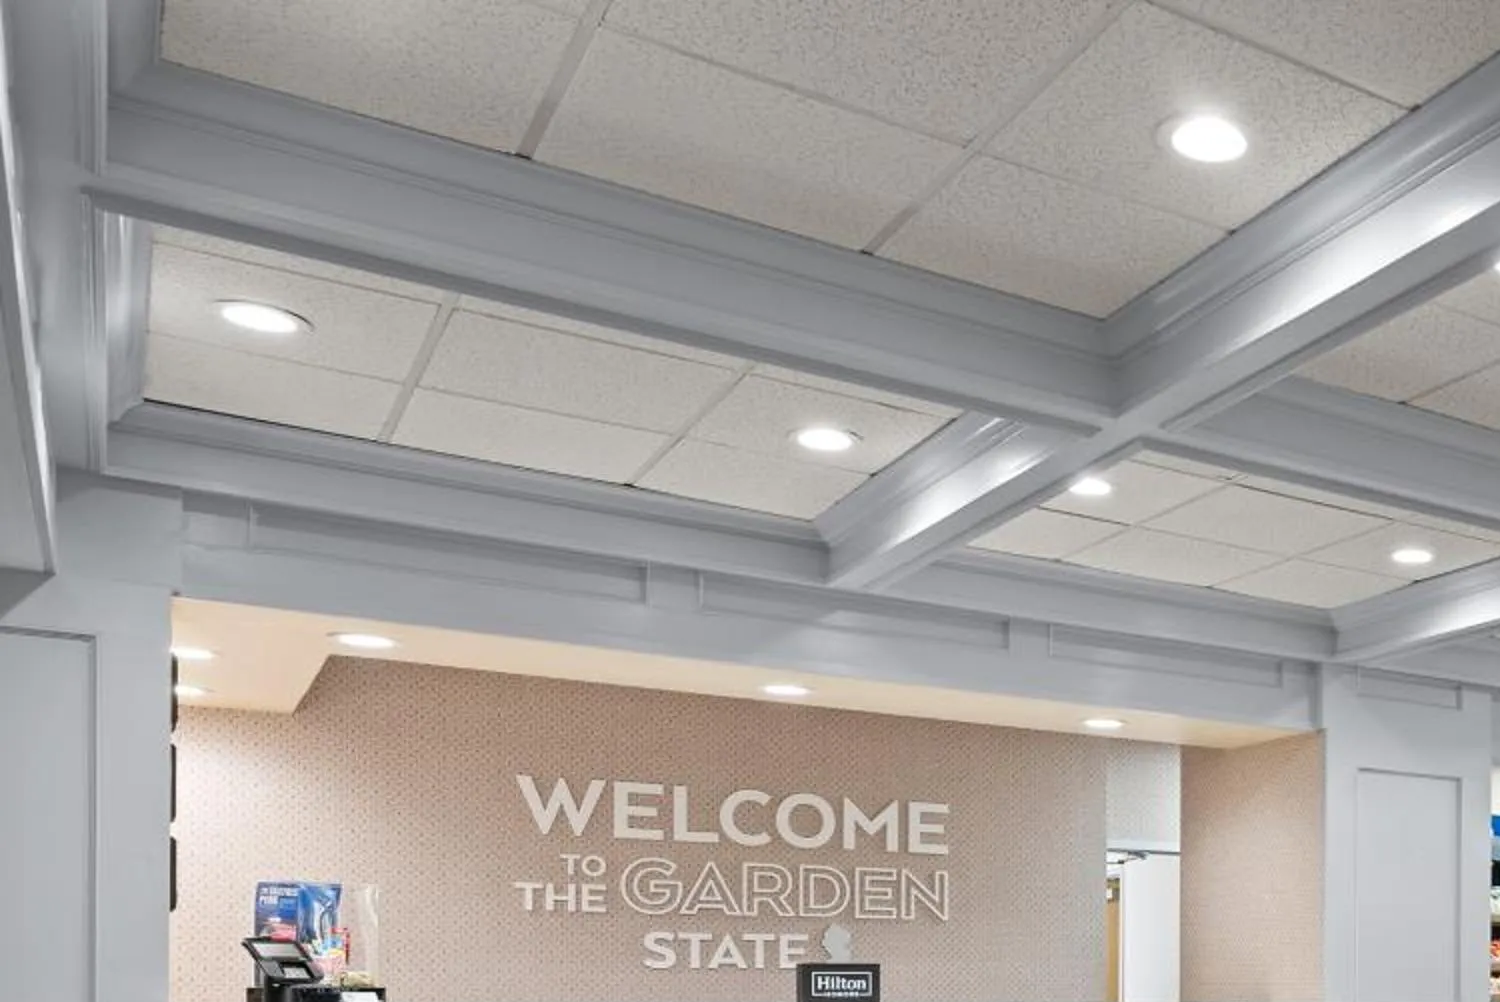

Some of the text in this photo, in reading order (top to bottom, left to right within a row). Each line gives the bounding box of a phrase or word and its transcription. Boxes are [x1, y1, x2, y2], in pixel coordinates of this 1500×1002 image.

[515, 774, 951, 856] WELCOME
[560, 853, 607, 878] TO
[514, 857, 950, 922] THE GARDEN
[643, 931, 809, 970] STATE
[817, 976, 867, 990] Hilton
